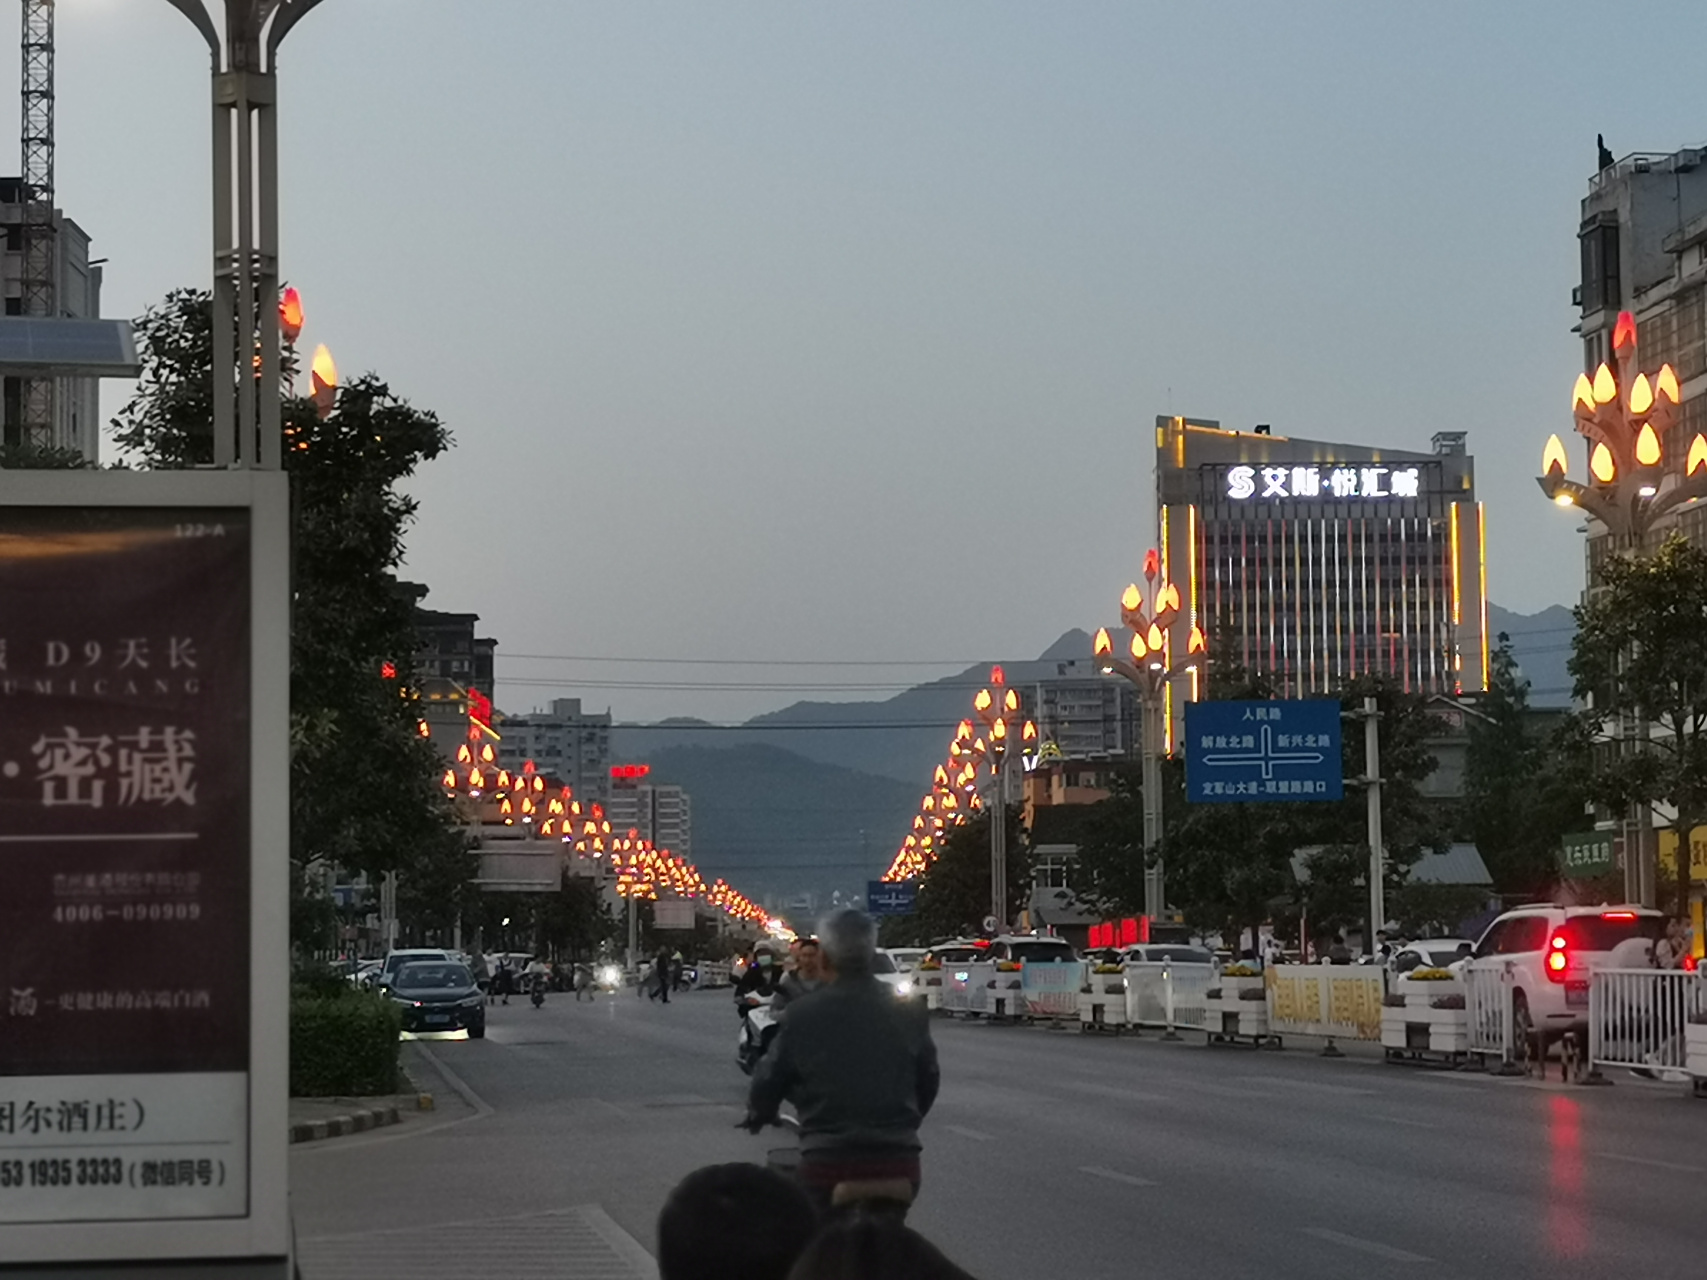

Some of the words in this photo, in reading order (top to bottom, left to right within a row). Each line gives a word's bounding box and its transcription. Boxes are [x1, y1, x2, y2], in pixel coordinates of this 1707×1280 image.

[174, 523, 226, 538] 122-A
[1242, 707, 1282, 721] 人民路
[1201, 735, 1255, 749] 解放北路
[1277, 734, 1331, 748] 新兴北路
[52, 902, 201, 923] 4006-090909
[29, 1158, 72, 1187] 1935
[77, 1157, 123, 1186] 3333
